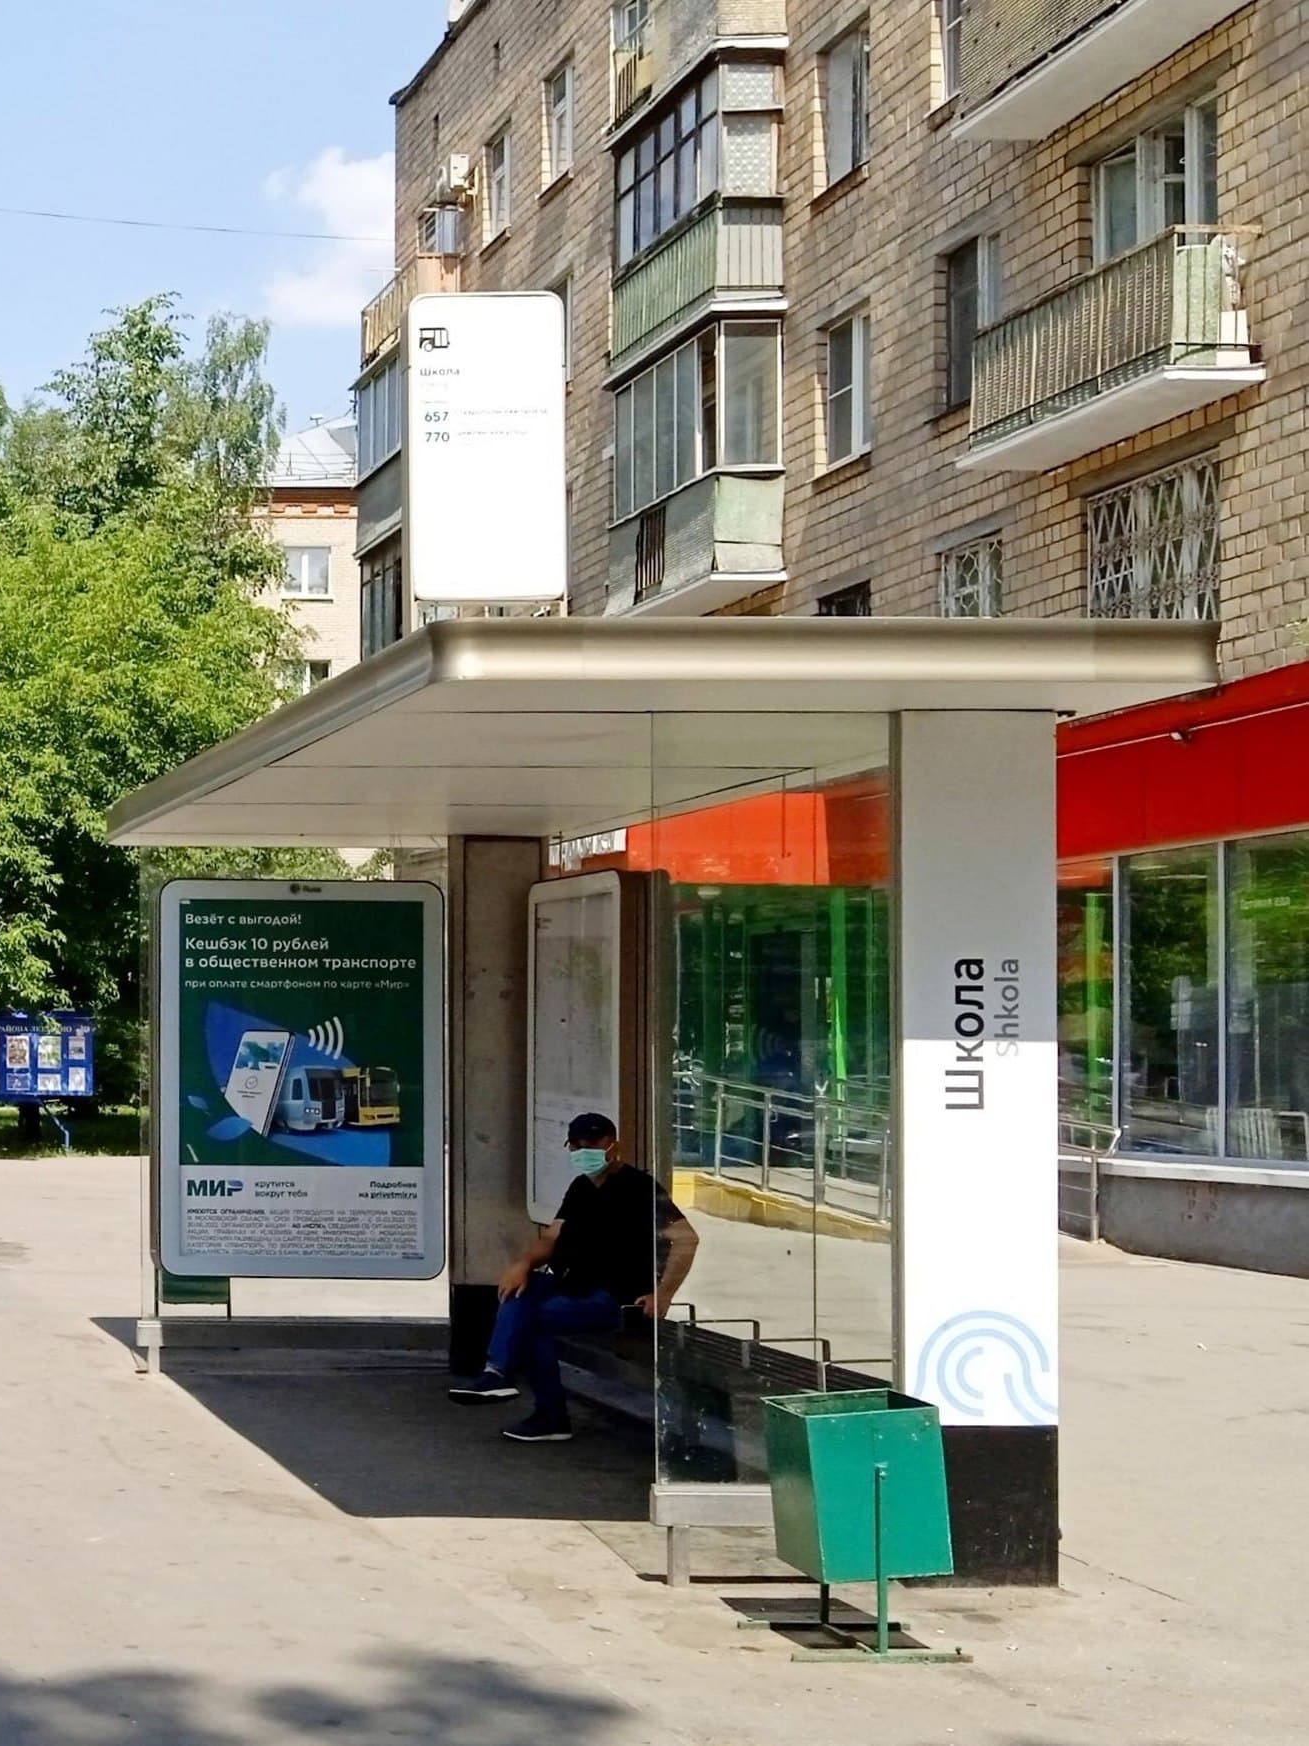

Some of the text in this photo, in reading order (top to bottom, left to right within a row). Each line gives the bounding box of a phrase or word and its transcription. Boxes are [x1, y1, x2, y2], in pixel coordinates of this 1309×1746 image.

[419, 367, 460, 376] Школа
[424, 411, 450, 423] 657
[425, 431, 451, 443] 770
[185, 913, 302, 926] Везёт с выгодой!
[185, 937, 329, 953] Кешбэк 10 рублей
[185, 955, 417, 971] в общественном транспорте
[185, 980, 206, 989] при
[209, 980, 247, 989] оплате
[250, 979, 321, 990] смартфоном
[323, 980, 337, 989] по
[340, 980, 372, 990] карте
[993, 958, 1019, 1059] Shkola
[944, 957, 985, 1111] Школа
[186, 1179, 243, 1197] МИР
[254, 1180, 296, 1190] крутится
[369, 1180, 417, 1190] Подробнее
[254, 1189, 308, 1200] вокруг тебя
